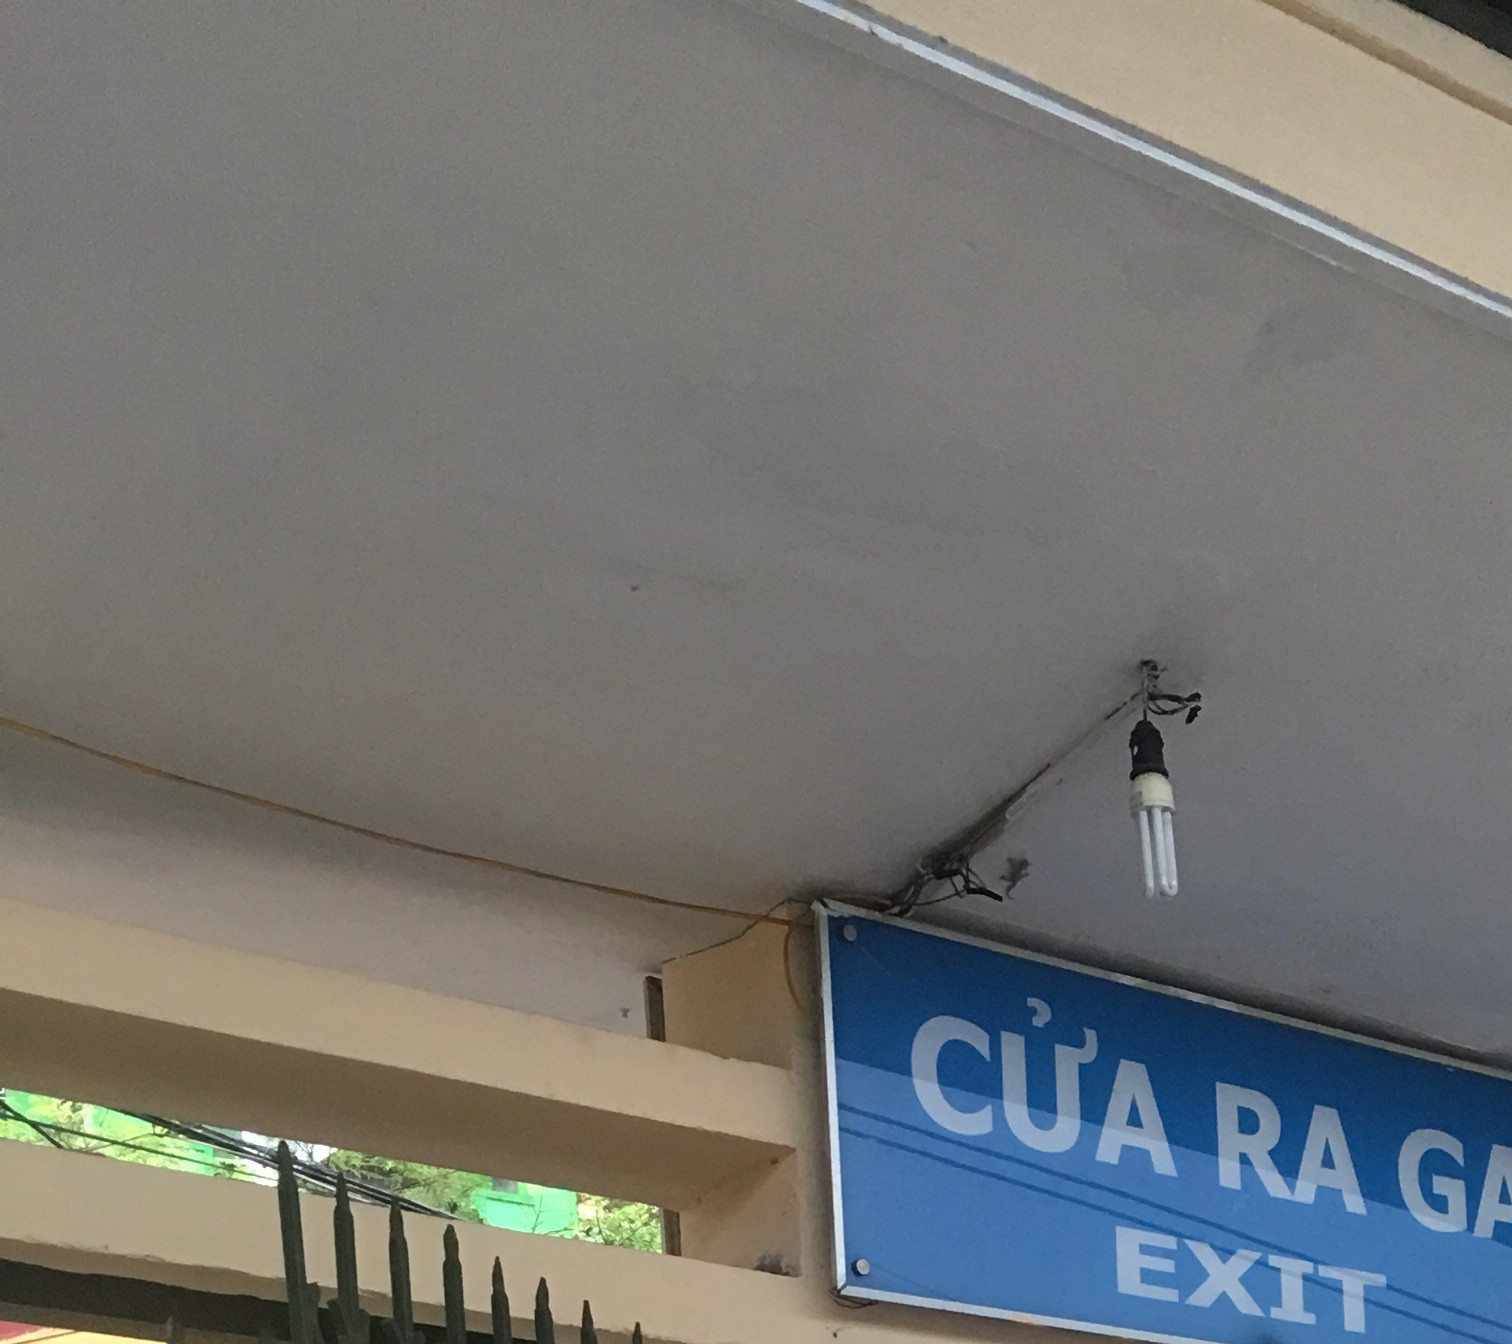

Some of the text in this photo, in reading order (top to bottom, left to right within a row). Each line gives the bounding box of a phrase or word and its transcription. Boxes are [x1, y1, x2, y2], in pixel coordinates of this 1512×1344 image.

[911, 997, 1177, 1177] CỬA
[1216, 1082, 1367, 1214] RA
[1115, 1225, 1387, 1333] EXIT
